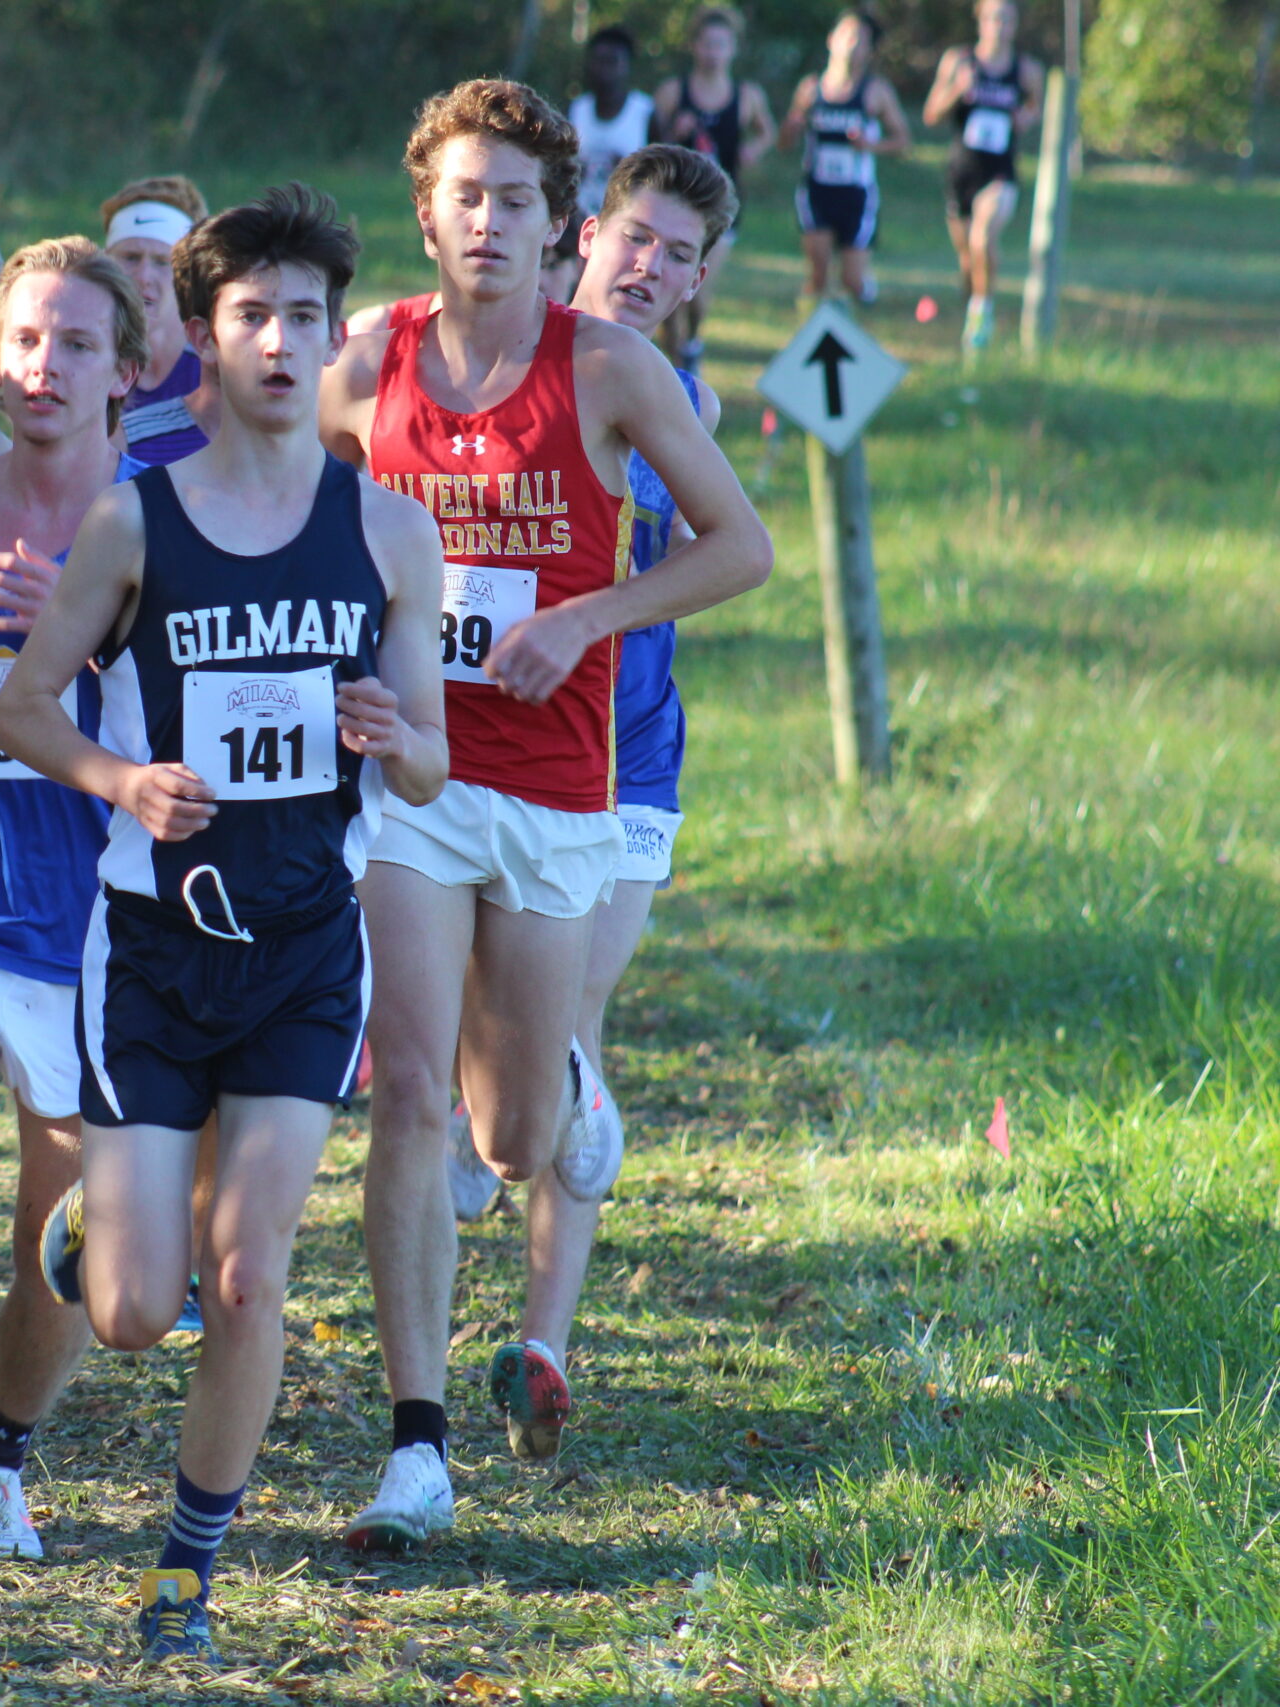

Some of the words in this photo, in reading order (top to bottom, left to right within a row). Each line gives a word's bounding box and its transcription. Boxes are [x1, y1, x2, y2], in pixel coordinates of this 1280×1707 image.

[497, 469, 568, 516] HALL
[441, 519, 572, 556] DINALS
[443, 574, 496, 604] IAA
[165, 598, 367, 667] GILMAN
[226, 683, 301, 712] MIAA
[219, 723, 305, 784] 141
[626, 840, 656, 861] DONS
